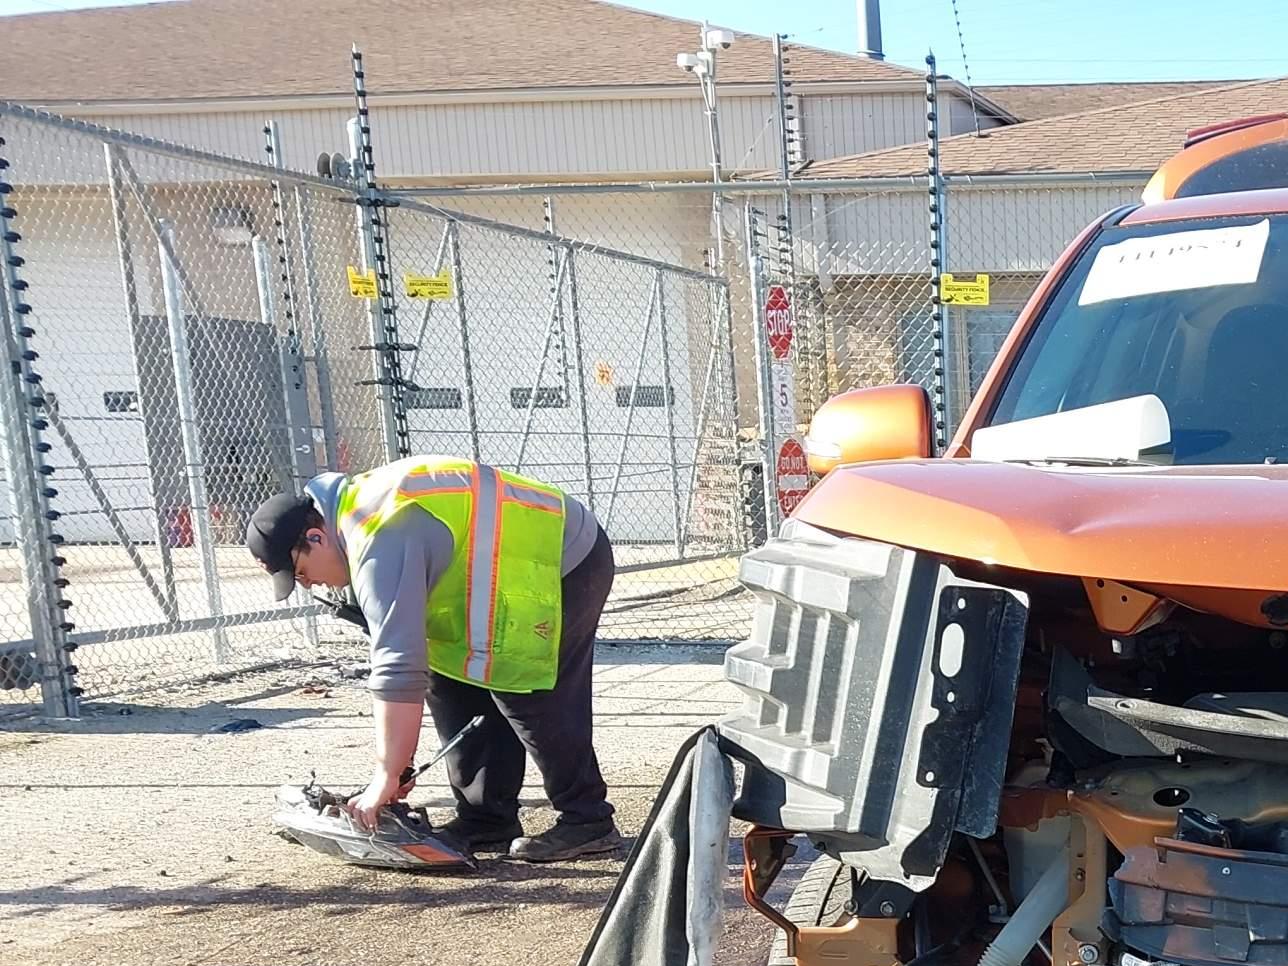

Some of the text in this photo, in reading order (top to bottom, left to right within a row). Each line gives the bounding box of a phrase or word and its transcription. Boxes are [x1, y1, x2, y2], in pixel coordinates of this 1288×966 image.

[767, 309, 790, 336] STOP
[780, 383, 789, 407] 5
[792, 457, 804, 470] NOT
